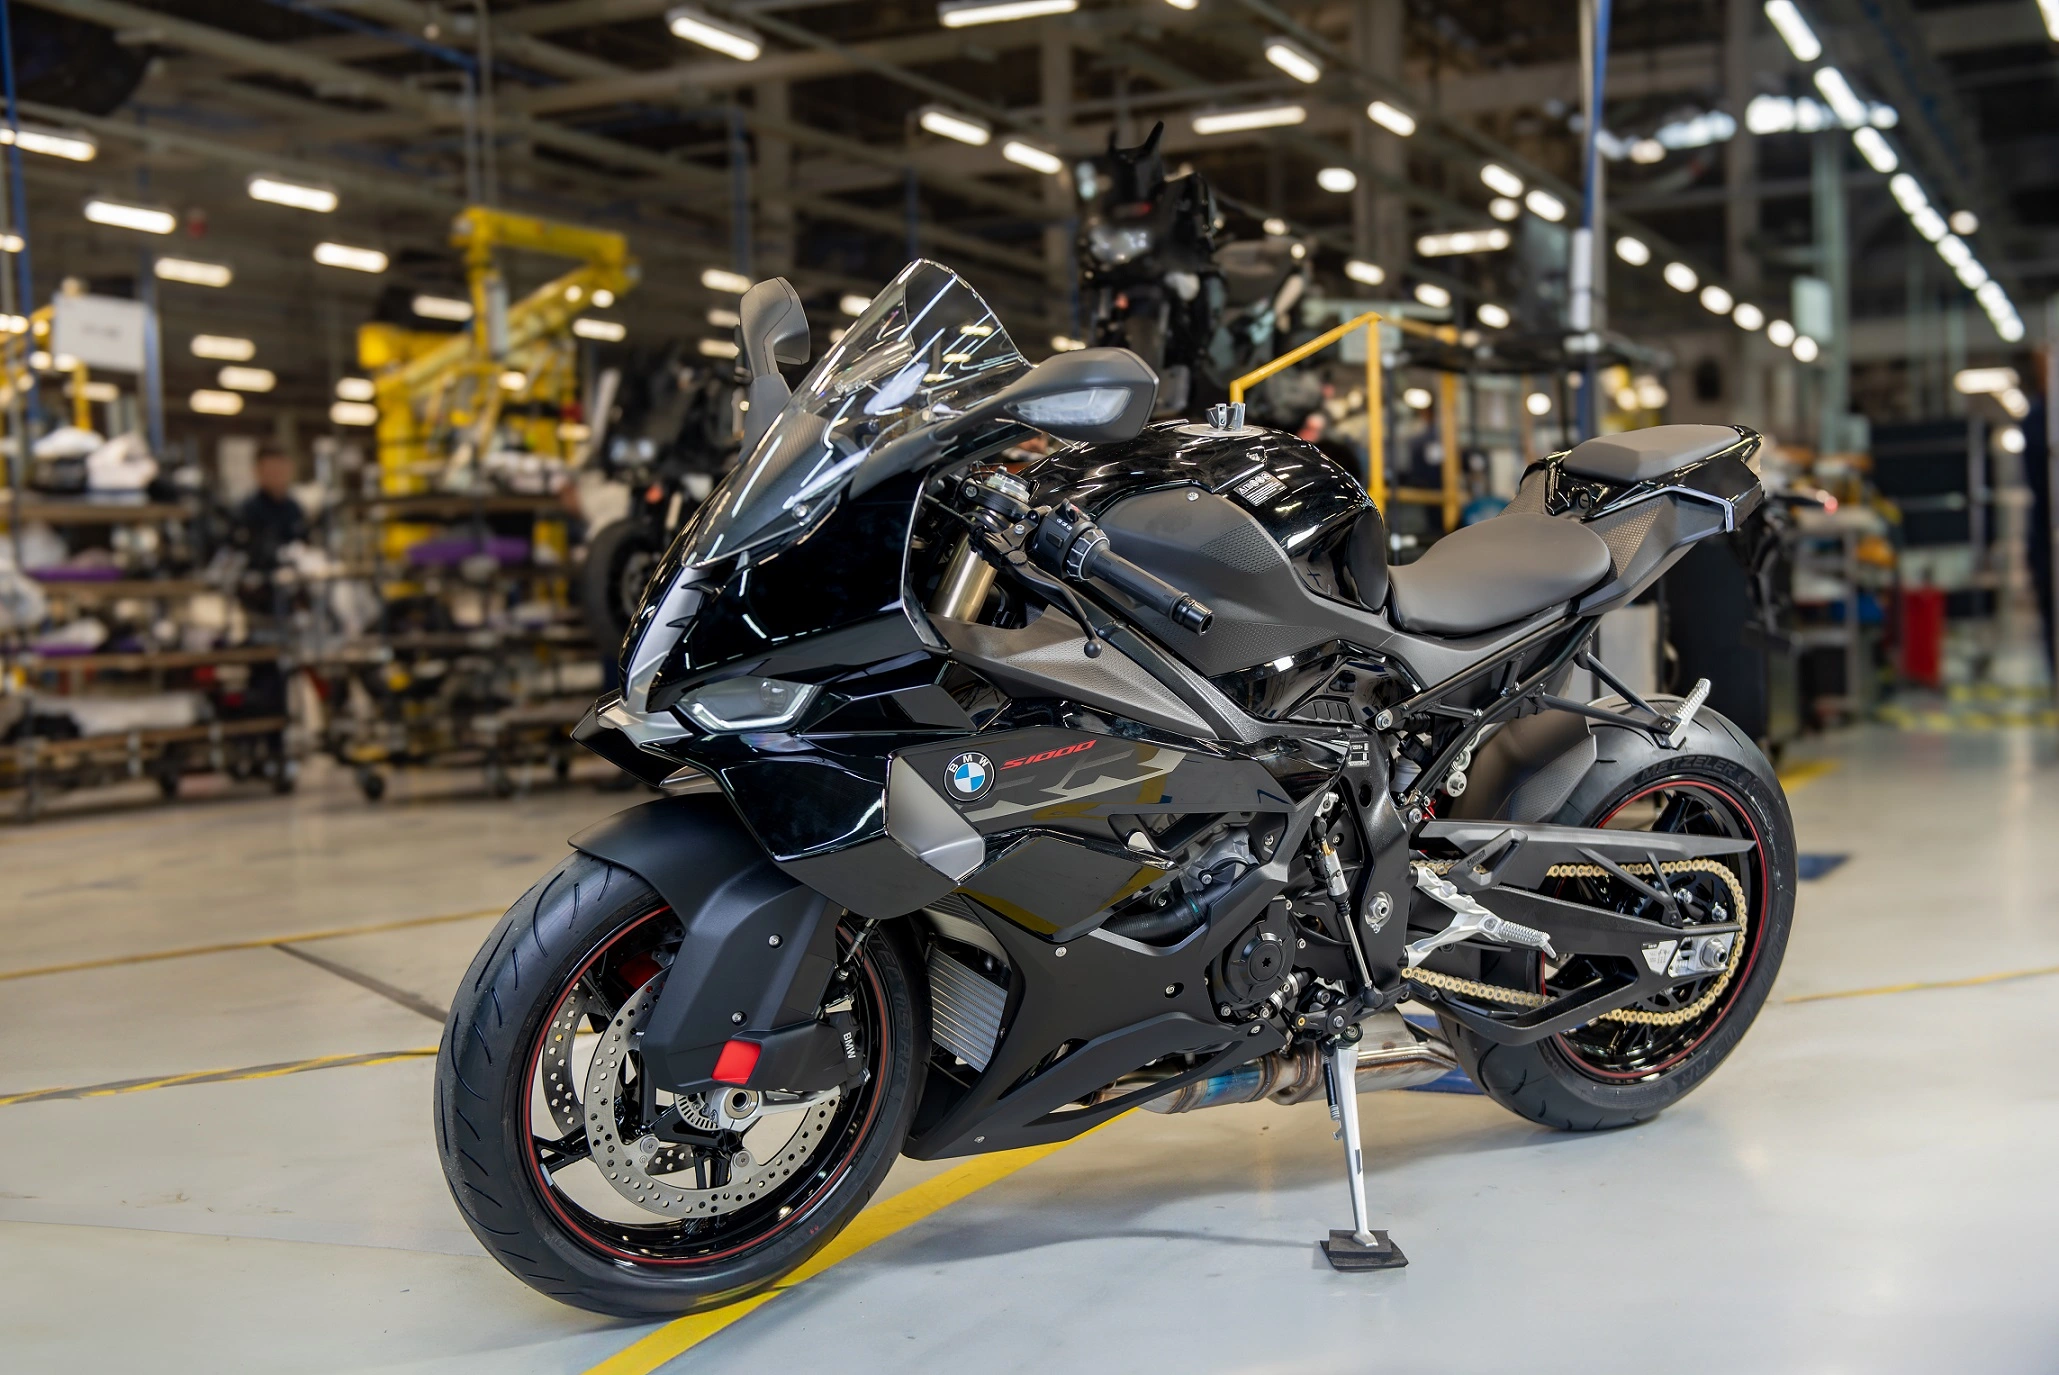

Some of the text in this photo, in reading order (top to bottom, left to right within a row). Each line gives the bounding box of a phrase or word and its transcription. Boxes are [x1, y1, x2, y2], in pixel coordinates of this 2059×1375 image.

[948, 754, 991, 773] BMW
[1000, 739, 1097, 770] S1000
[1641, 756, 1737, 781] METZELER
[843, 1031, 857, 1059] BMW
